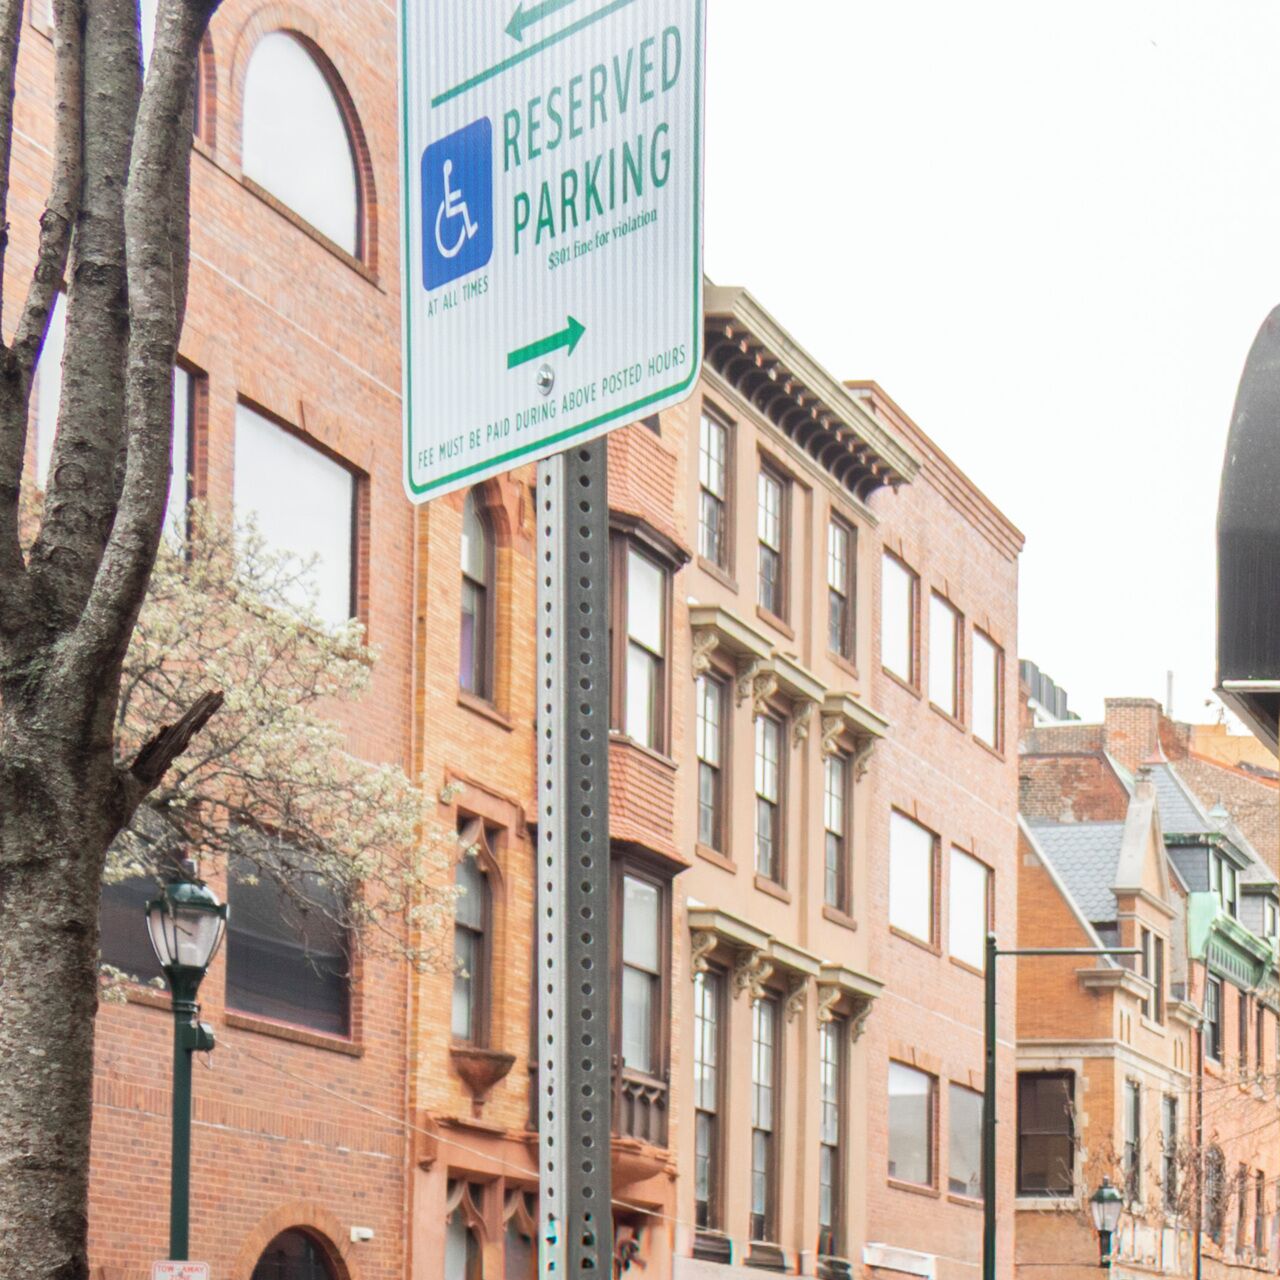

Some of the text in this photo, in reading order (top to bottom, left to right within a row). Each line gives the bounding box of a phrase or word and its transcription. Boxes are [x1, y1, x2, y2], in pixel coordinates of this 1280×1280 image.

[503, 25, 682, 173] RESERVED
[513, 122, 672, 256] PARKING
[548, 208, 658, 271] $301 fine for violation
[428, 275, 489, 317] AT ALL TIMES
[418, 345, 686, 469] FEE MUST BE PAID DURING ABOVE POSTED HOURS
